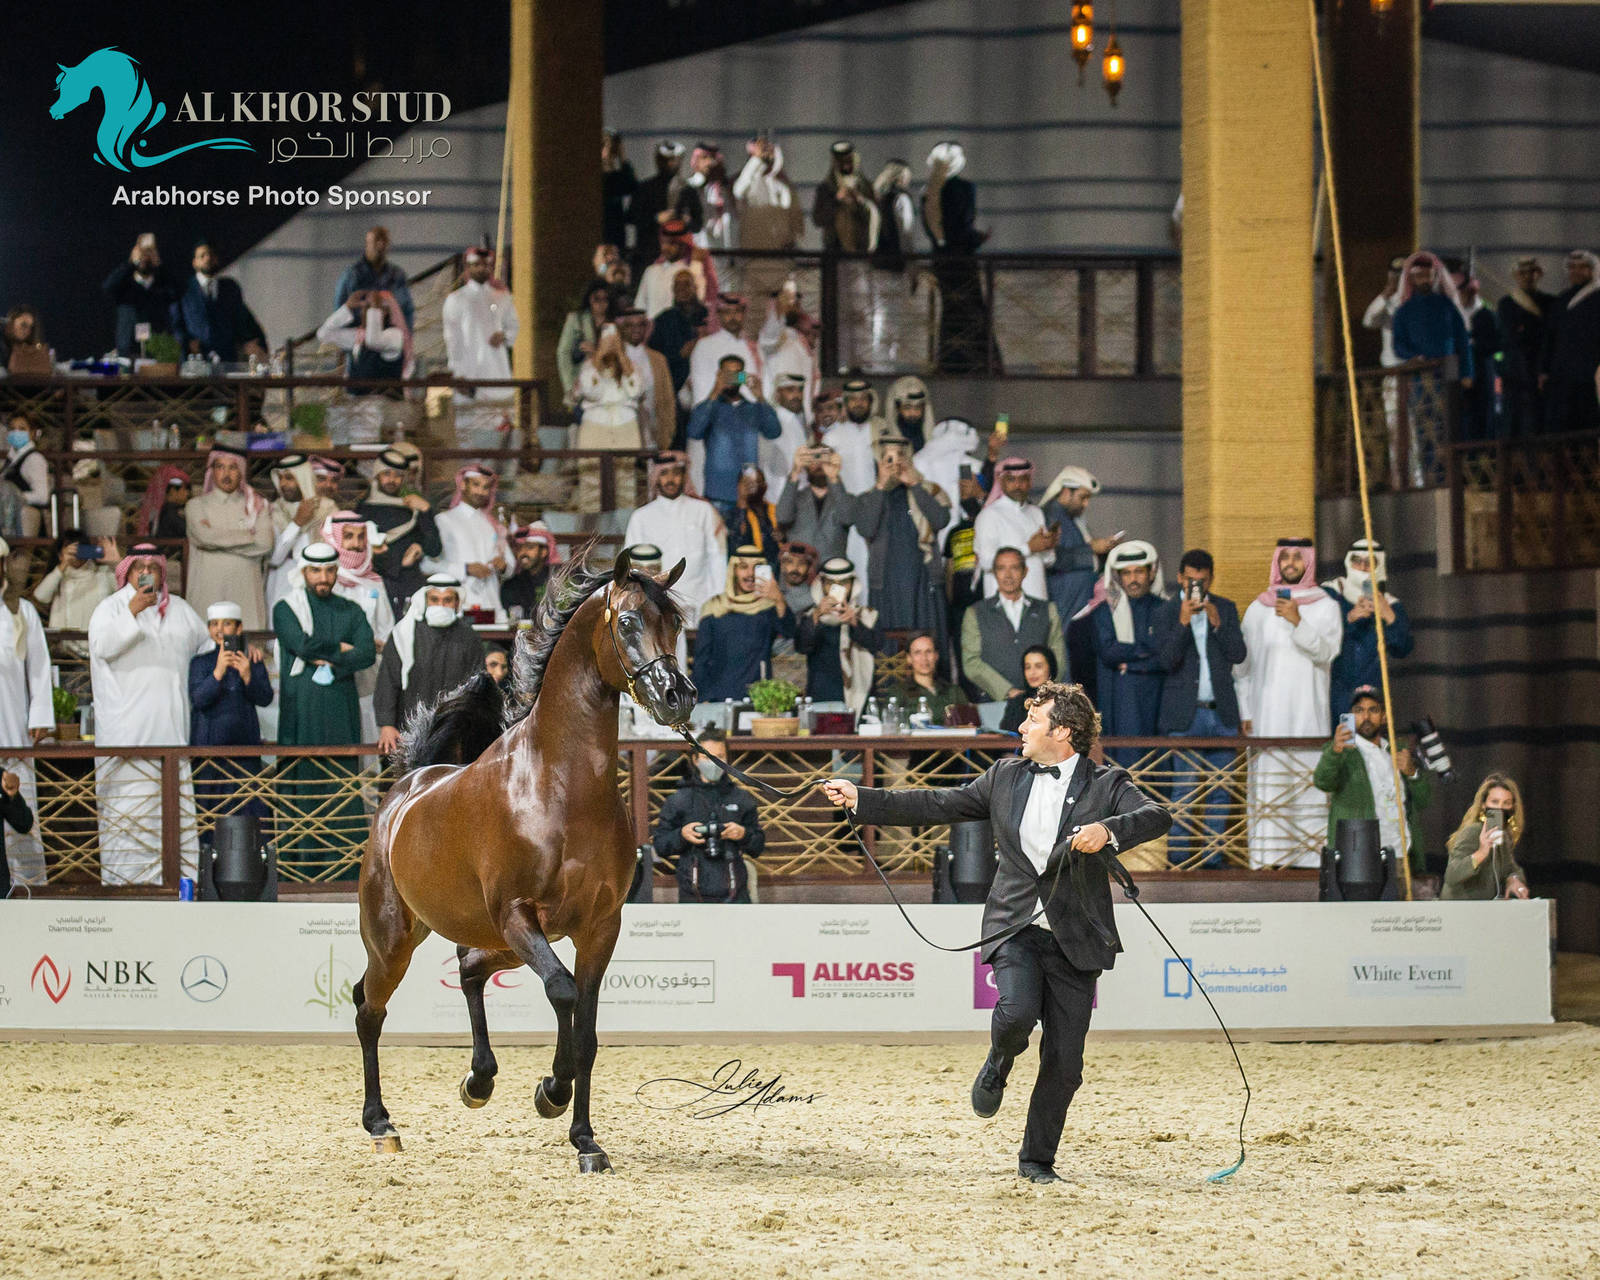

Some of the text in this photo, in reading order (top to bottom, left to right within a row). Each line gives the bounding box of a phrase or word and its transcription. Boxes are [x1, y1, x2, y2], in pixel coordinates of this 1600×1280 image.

[48, 925, 113, 934] Diamond Sponsor
[299, 927, 360, 936] Diamond Sponso
[86, 960, 157, 985] NBK
[812, 962, 915, 982] ALKASS
[1353, 964, 1453, 981] White Event
[603, 974, 657, 991] JOVOY
[656, 972, 711, 991] جوفوي
